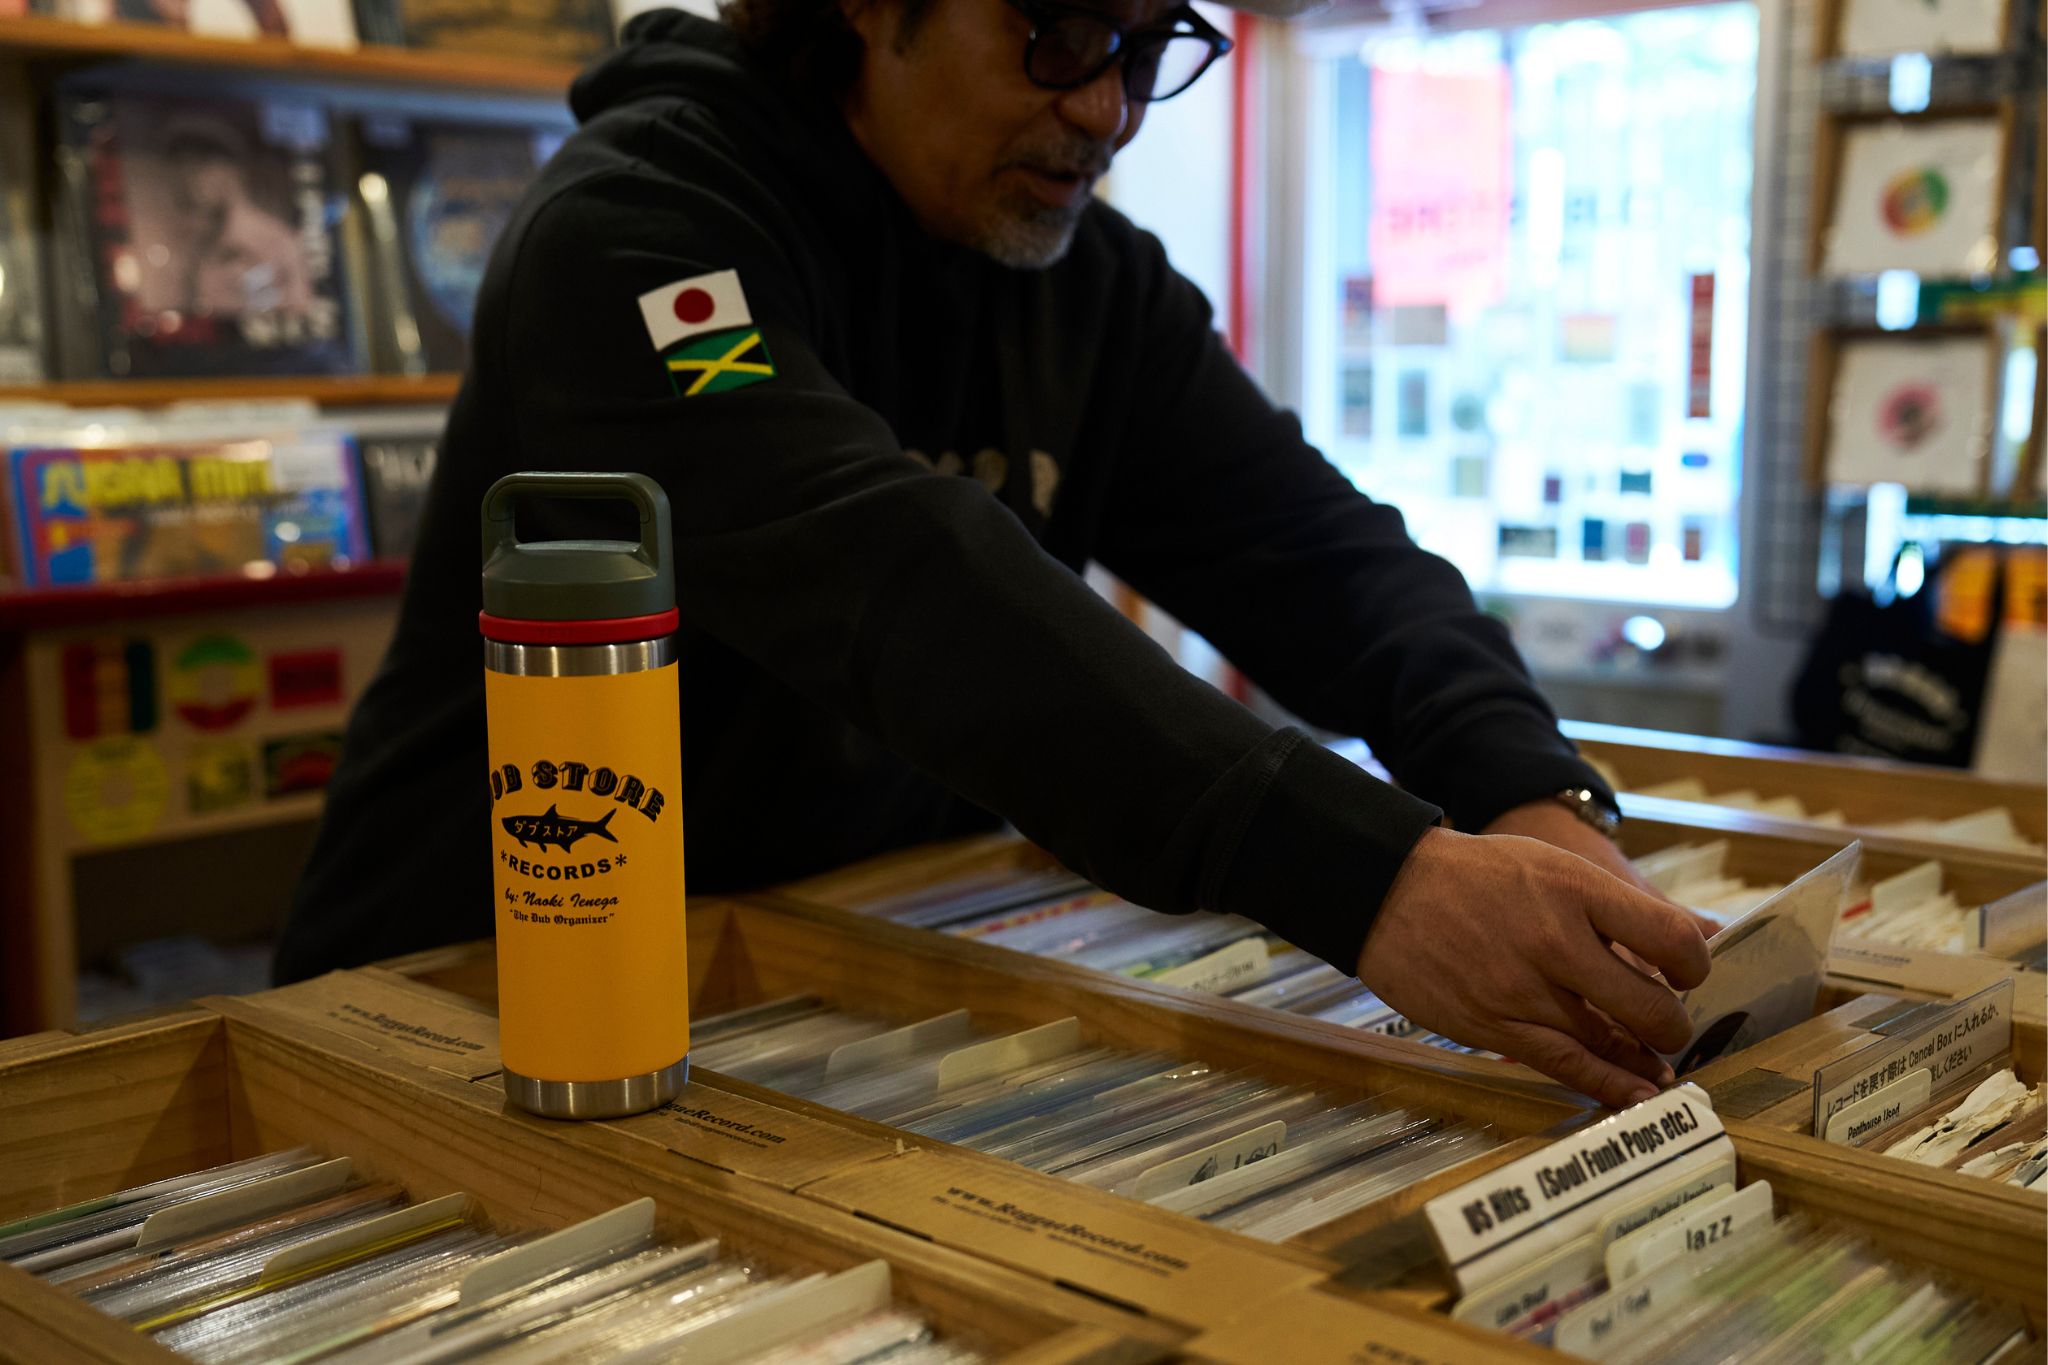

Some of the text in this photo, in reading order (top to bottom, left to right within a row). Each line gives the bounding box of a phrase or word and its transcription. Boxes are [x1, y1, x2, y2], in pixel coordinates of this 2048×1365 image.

[490, 760, 665, 823] UB STORE
[514, 820, 578, 837] ダブストア
[505, 887, 519, 904] by:
[522, 891, 564, 908] Naoki
[531, 912, 551, 924] Dub
[1908, 1037, 1935, 1068] Cancel
[1936, 1031, 1953, 1052] Box
[1883, 1102, 1900, 1121] Used
[1461, 1199, 1494, 1236] US
[1487, 1184, 1531, 1224] Hits
[1582, 1137, 1628, 1178] Funk
[1619, 1122, 1665, 1158] Pops
